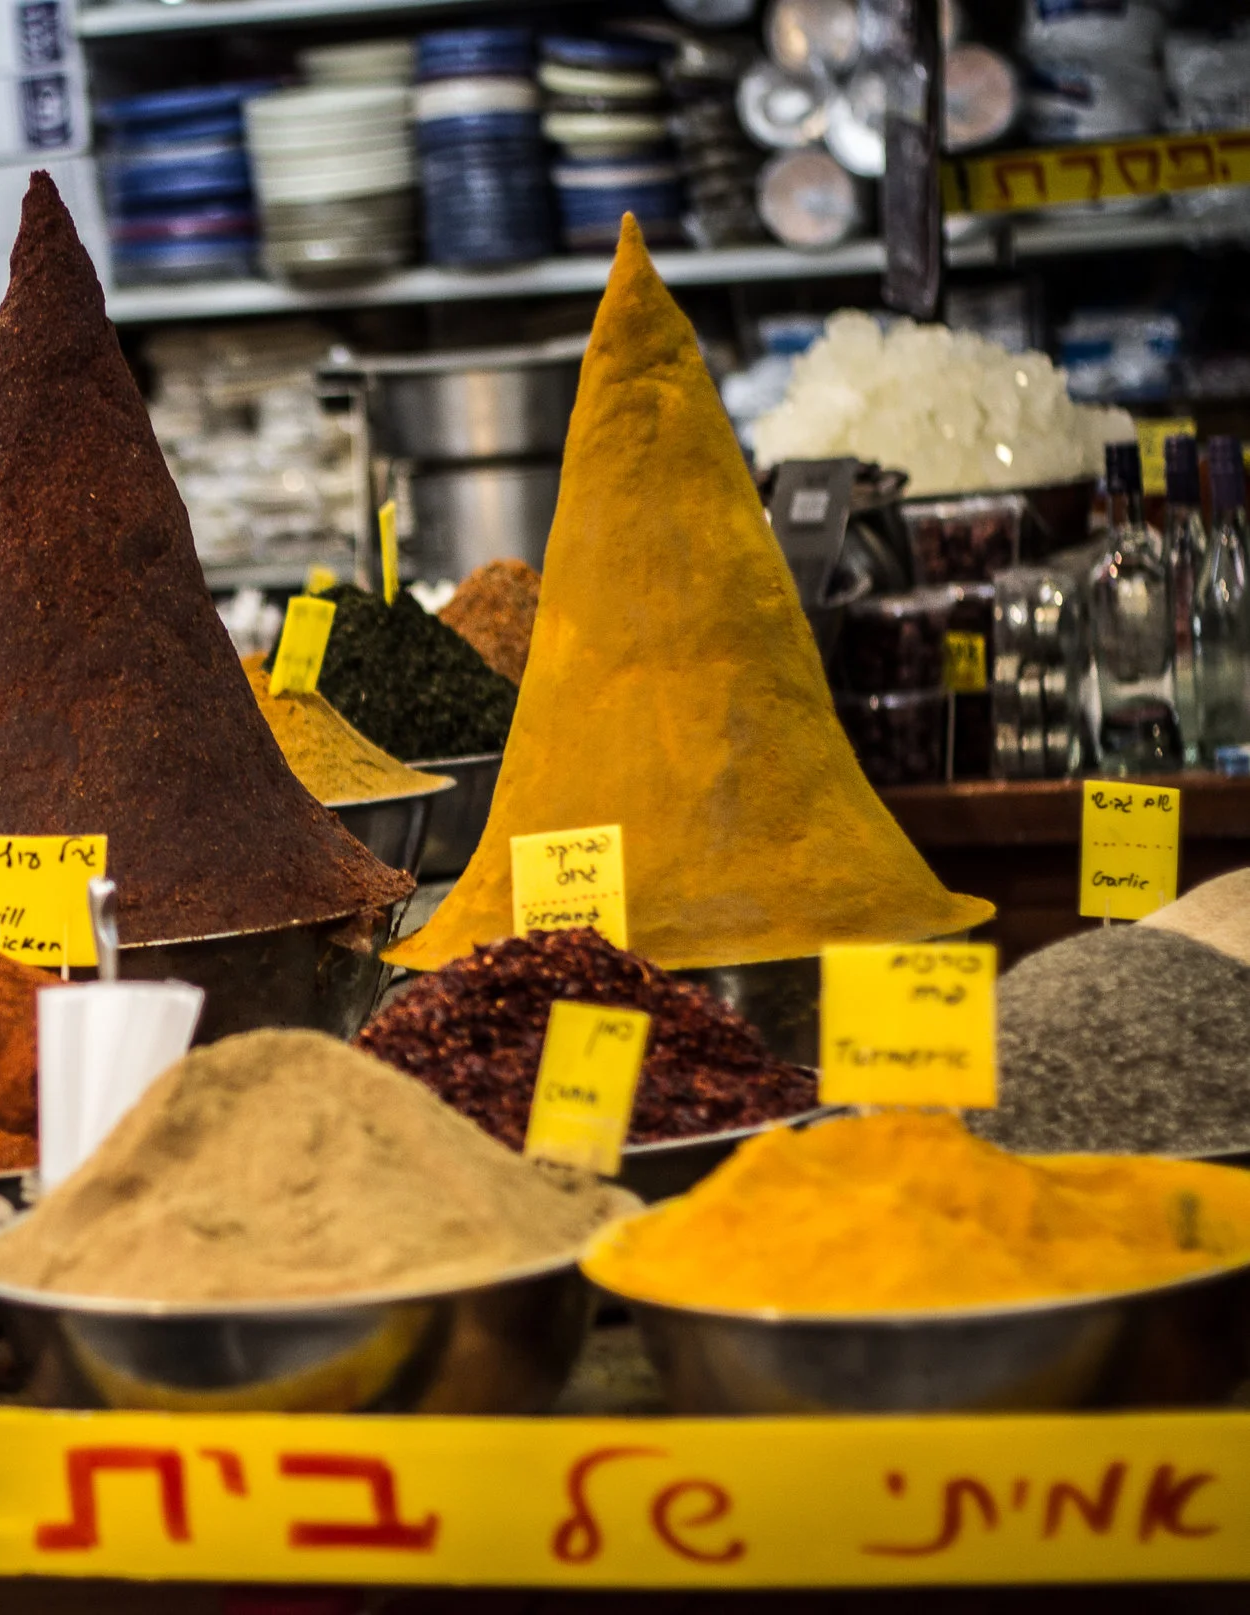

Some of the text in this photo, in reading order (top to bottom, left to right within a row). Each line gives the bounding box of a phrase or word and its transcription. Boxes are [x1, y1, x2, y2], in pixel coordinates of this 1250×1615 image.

[1092, 871, 1149, 890] Garlic
[34, 1444, 441, 1553] בית
[549, 1445, 748, 1567] של
[858, 1461, 1223, 1557] אמיתי
